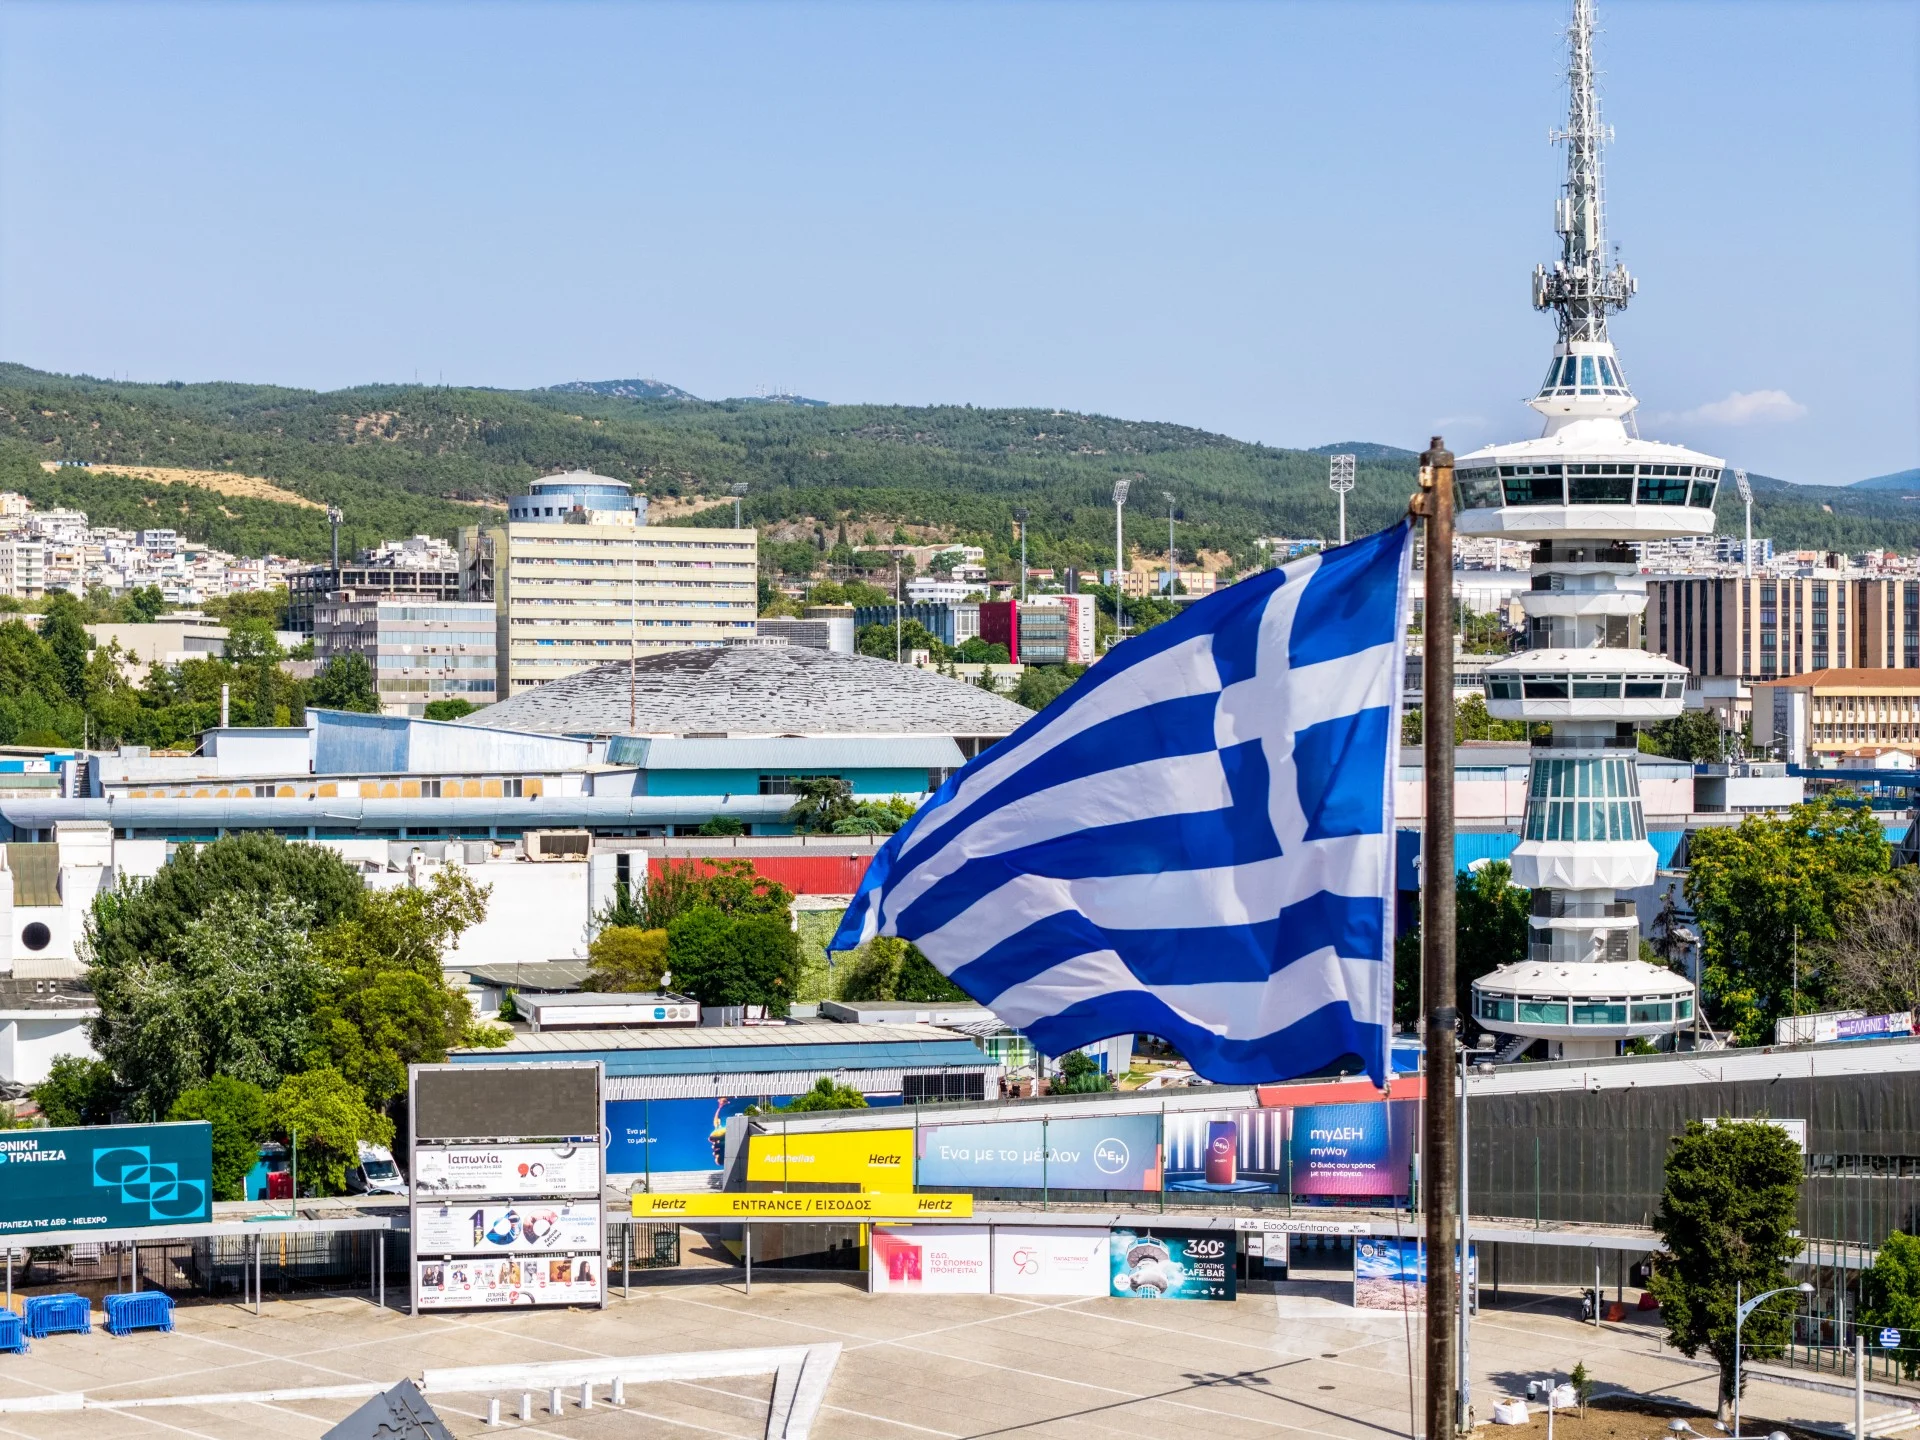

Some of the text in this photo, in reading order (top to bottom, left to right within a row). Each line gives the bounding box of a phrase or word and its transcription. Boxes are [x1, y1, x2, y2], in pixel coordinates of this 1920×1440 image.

[1311, 1128, 1363, 1142] myΔΕΗ
[8, 1150, 66, 1162] ΤΡΑΠΕΖΑ
[940, 1146, 1080, 1164] Ένα με το μέλον
[1098, 1148, 1124, 1164] ΔΕΗ
[1311, 1147, 1347, 1157] myWay
[448, 1153, 502, 1164] Ιαπωνία.
[868, 1154, 901, 1164] Hertz
[1318, 1161, 1335, 1170] δικός
[1351, 1162, 1376, 1170] τρόπος
[652, 1199, 952, 1210] Hertz ENTRANCE / ΕΙΣΟΔΟΣ Hertz
[0, 1221, 33, 1229] ΤΡΑΠΕΖΑ
[1013, 1250, 1038, 1274] 95
